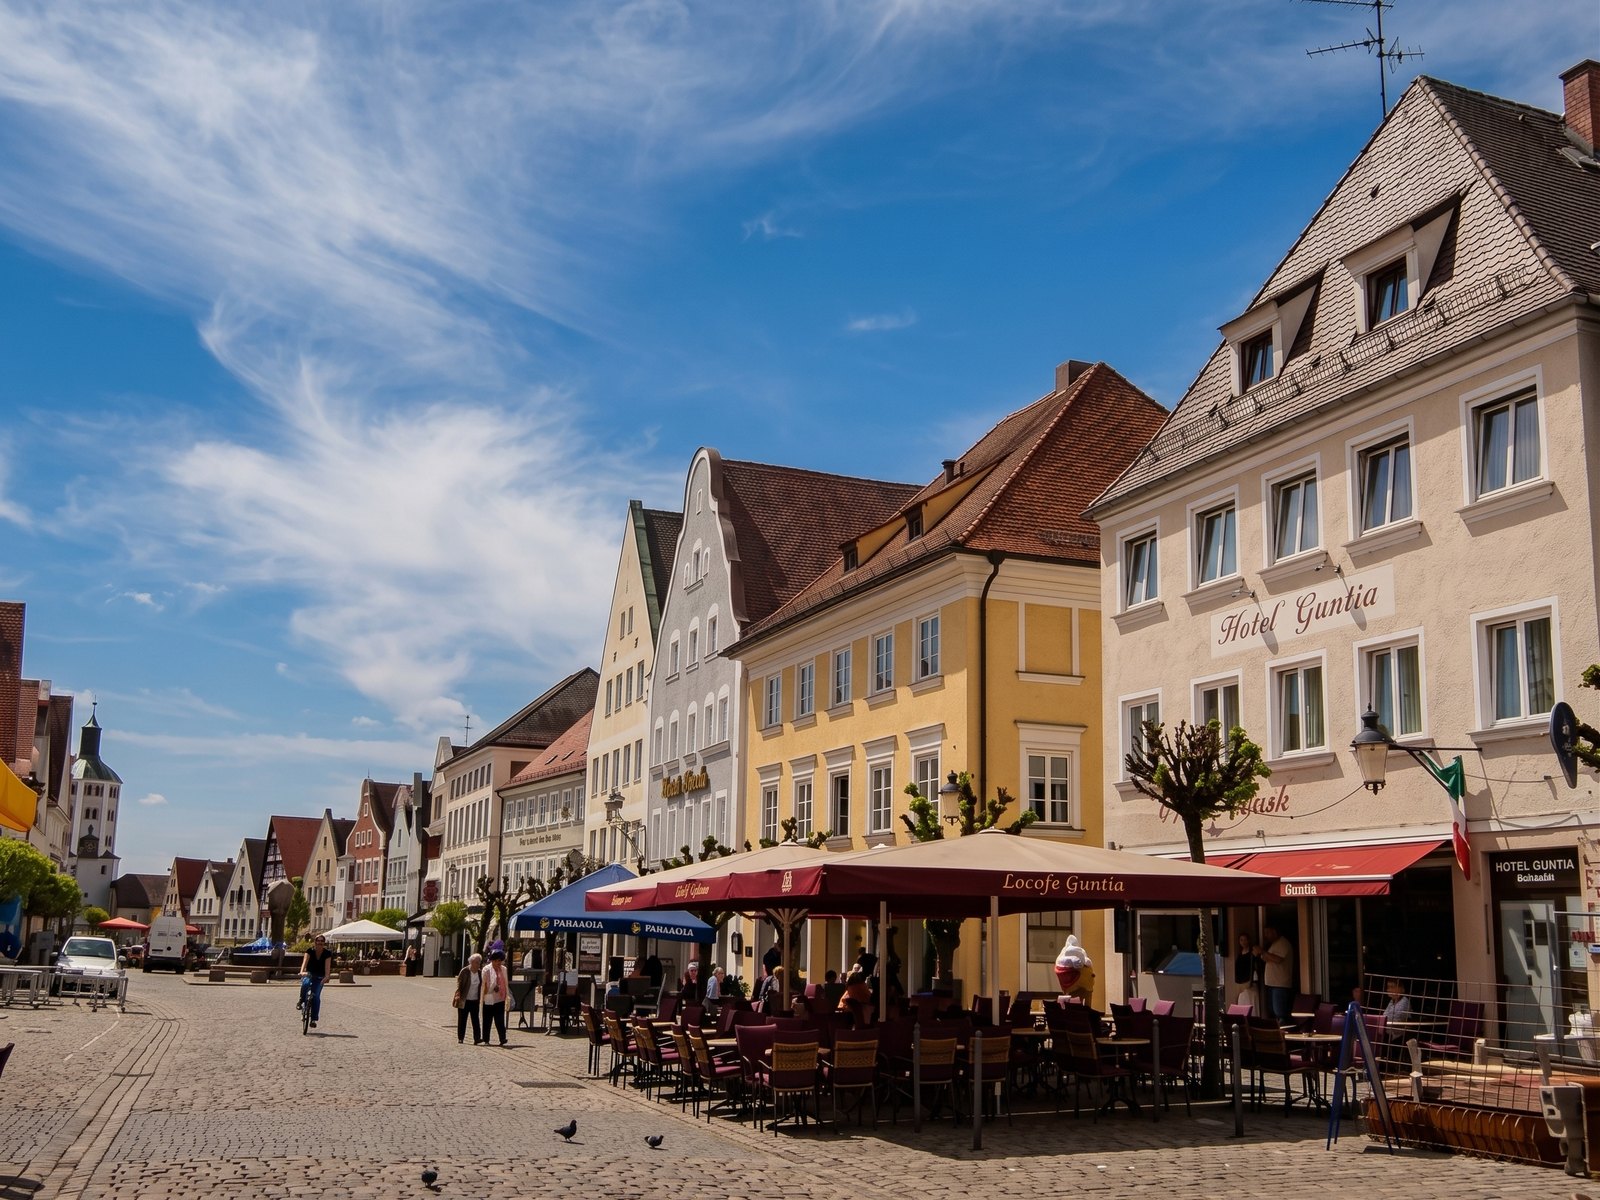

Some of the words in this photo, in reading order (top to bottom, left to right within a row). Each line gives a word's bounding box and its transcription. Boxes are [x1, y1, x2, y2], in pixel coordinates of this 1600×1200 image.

[1218, 599, 1286, 645] Hotel
[1295, 584, 1378, 635] Guntia
[1495, 861, 1530, 872] HOTEL
[1532, 858, 1575, 871] GUNTIA
[1002, 873, 1060, 896] Locofe
[1066, 875, 1125, 894] Guntia
[1285, 883, 1317, 895] Guntia
